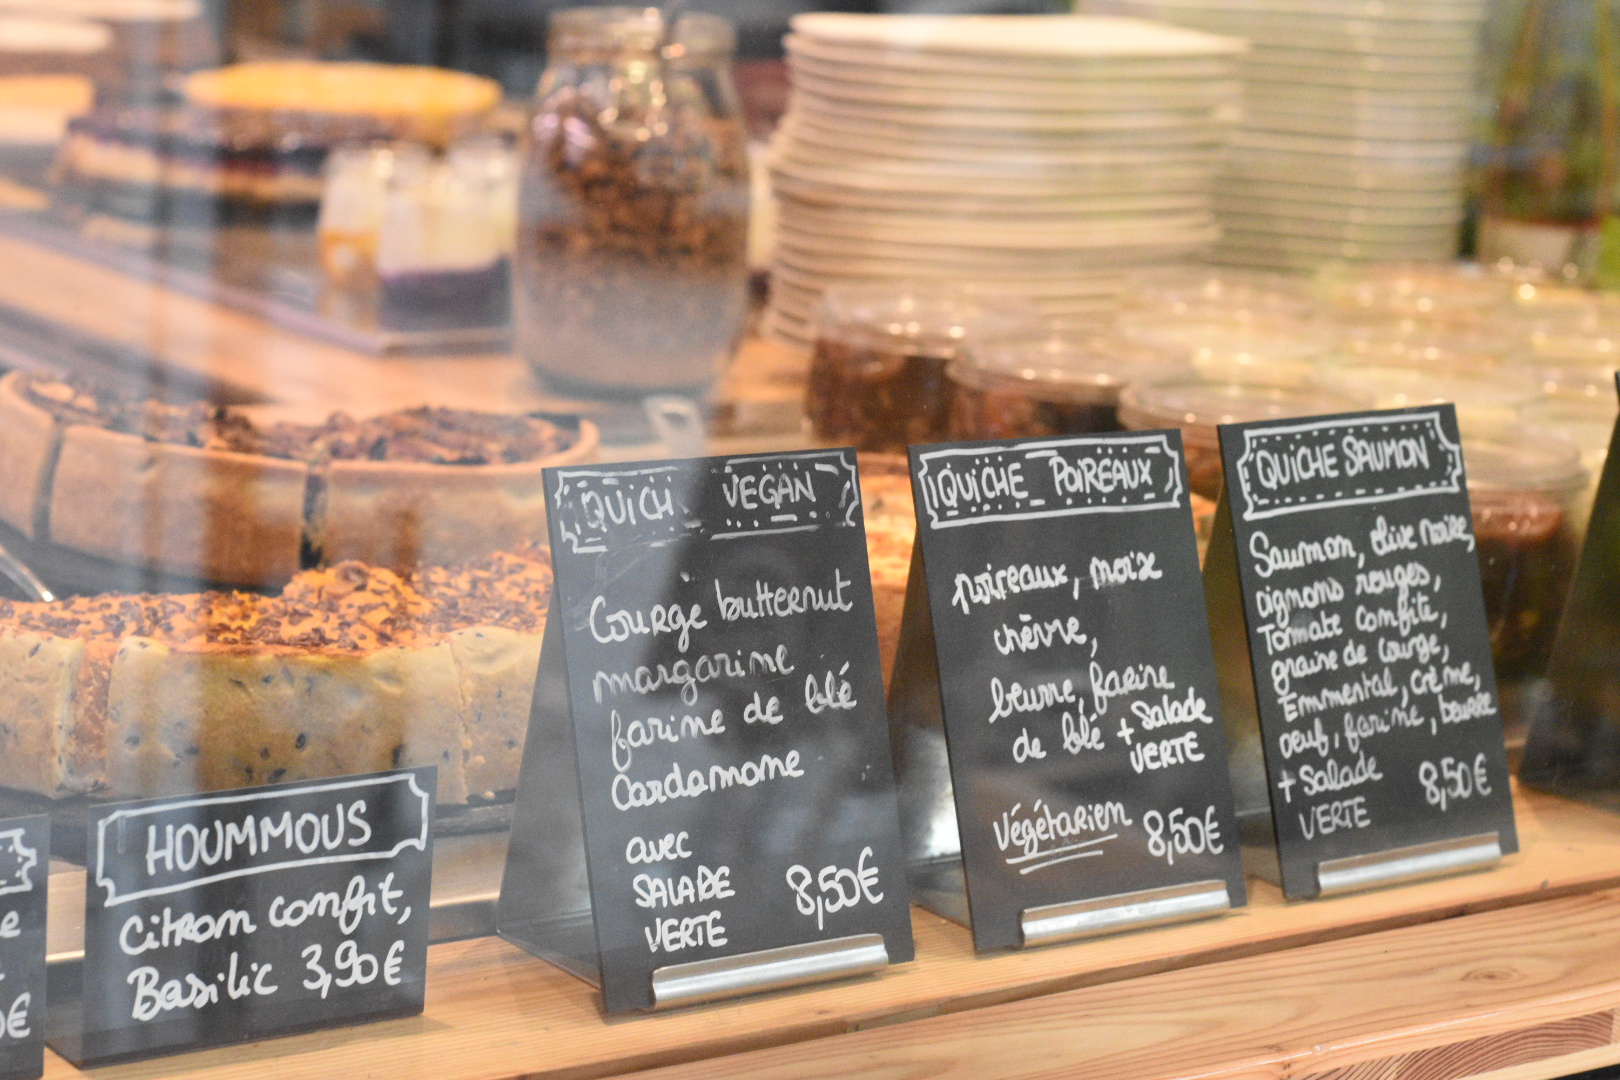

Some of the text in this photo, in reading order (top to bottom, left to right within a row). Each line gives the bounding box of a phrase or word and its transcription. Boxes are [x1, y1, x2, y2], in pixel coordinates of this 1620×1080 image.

[1342, 435, 1430, 477] SAUMON
[722, 471, 817, 510] VEGAN
[1250, 531, 1365, 578] Saumon,
[1355, 561, 1441, 604] rouges,
[590, 568, 852, 653] Courge butternut
[952, 562, 1080, 615] poireaux,
[1257, 610, 1343, 655] Tomate
[592, 644, 795, 706] margarine
[989, 661, 1175, 724] beurre, farine
[1271, 650, 1339, 696] graine
[1343, 639, 1368, 667] de
[1277, 666, 1408, 723] Emmental,
[611, 661, 857, 773] farine de blé
[1012, 727, 1046, 763] de
[1062, 713, 1105, 755] blé
[1117, 717, 1134, 745] +
[1343, 704, 1437, 754] farine,
[1438, 691, 1497, 724] beurre
[1130, 731, 1205, 774] VERTE
[1278, 769, 1296, 803] +
[1418, 752, 1492, 812] 8,50€
[146, 800, 372, 875] HOUMMOUS
[993, 799, 1224, 865] Végétarien 8,50€
[1299, 795, 1371, 840] VERTE
[625, 831, 692, 864] avec
[632, 846, 884, 930] SALADE 8,50€
[644, 910, 728, 953] VERTE
[127, 940, 405, 1021] Basilic 3,90€
